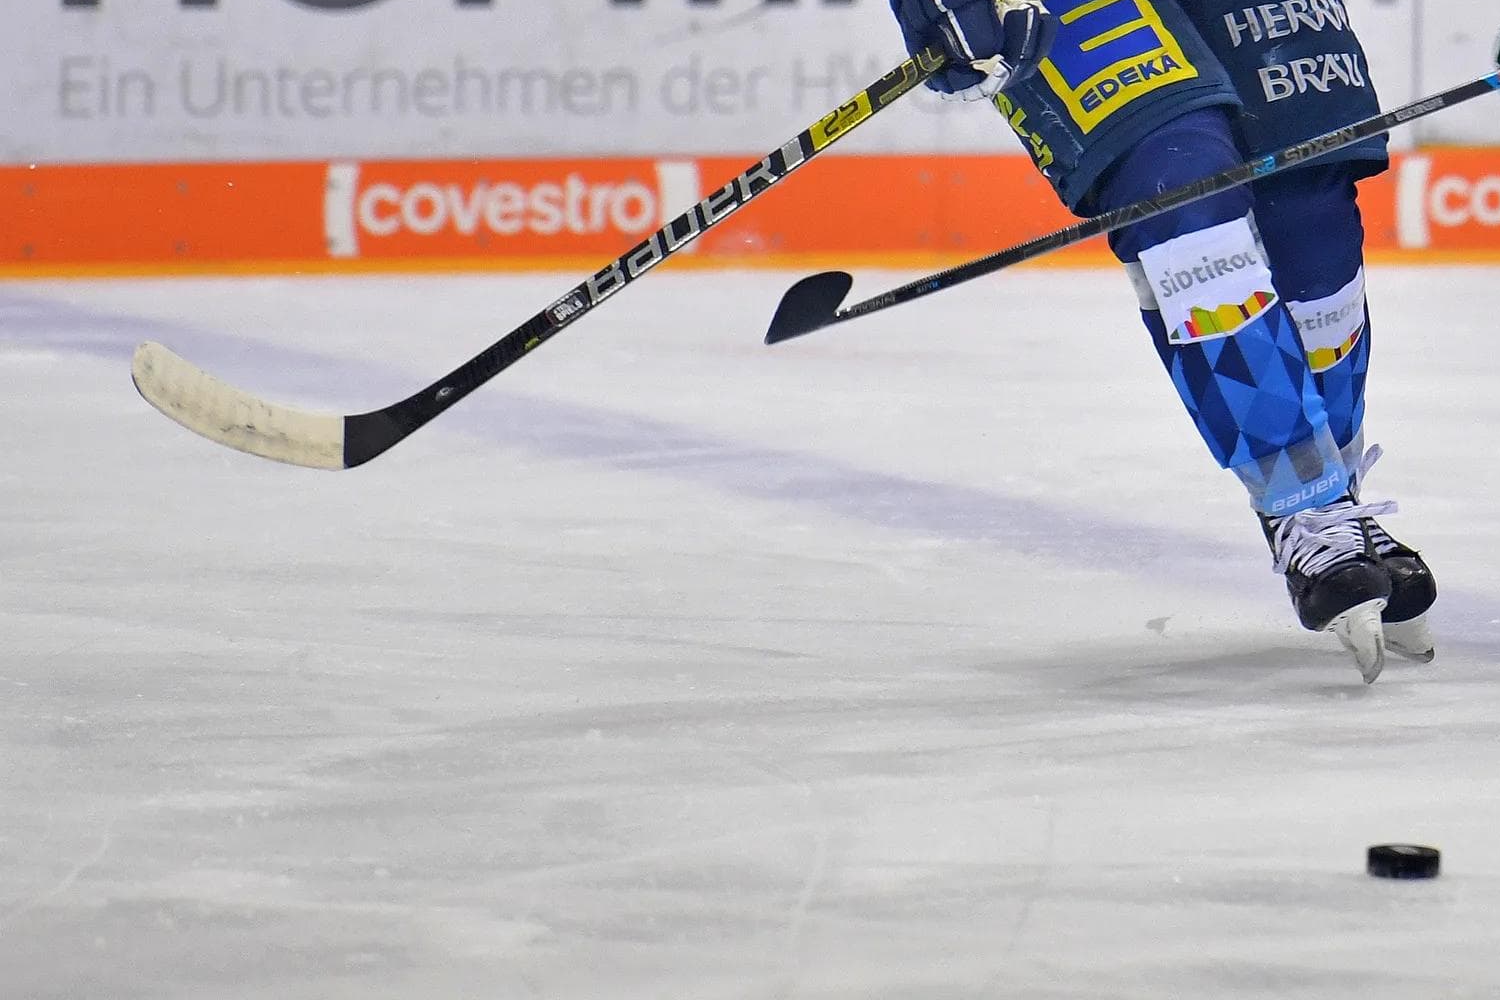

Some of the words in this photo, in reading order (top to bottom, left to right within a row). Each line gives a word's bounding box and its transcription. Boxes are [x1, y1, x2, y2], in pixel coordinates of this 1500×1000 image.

[58, 56, 156, 120] Ein
[180, 58, 642, 120] Unternehmen
[658, 57, 768, 118] der
[1080, 52, 1182, 113] EDEKA
[1256, 53, 1365, 103] BRÄU
[1283, 127, 1357, 163] NEXUS
[358, 174, 659, 237] covestro
[586, 156, 779, 307] BAUER
[1271, 470, 1340, 513] BAUER
